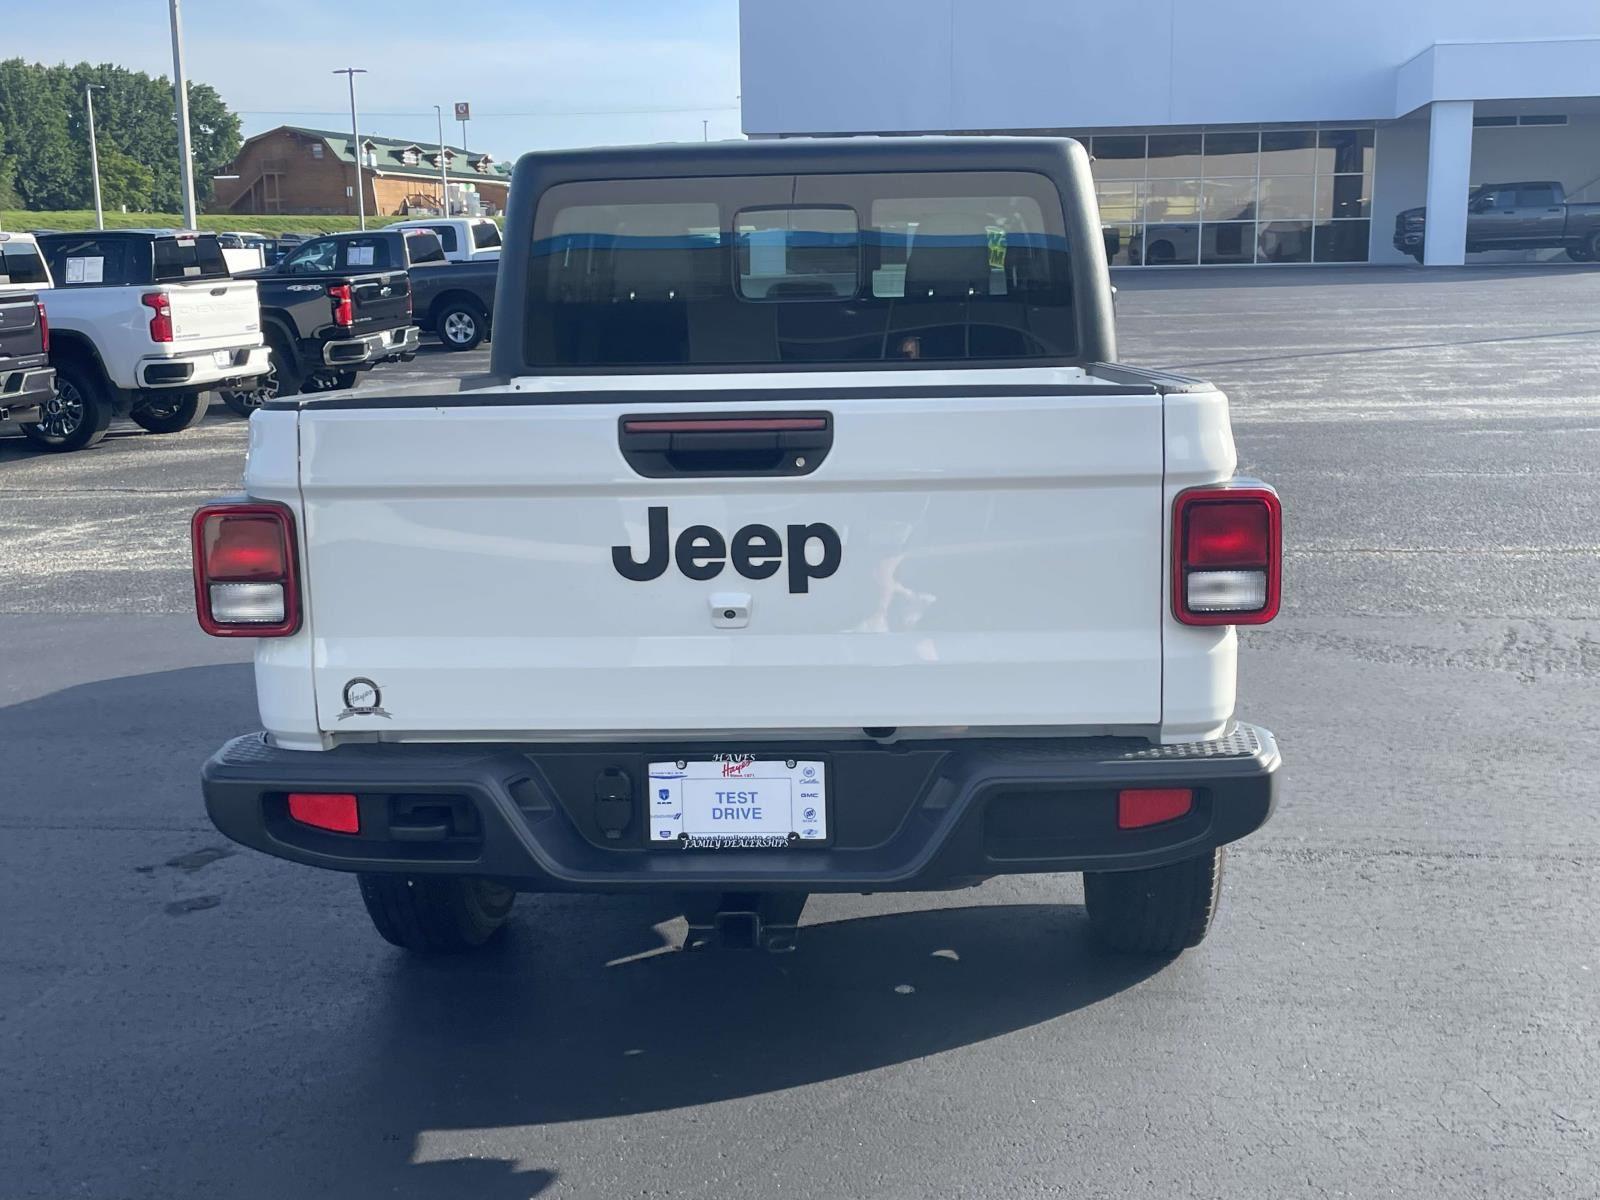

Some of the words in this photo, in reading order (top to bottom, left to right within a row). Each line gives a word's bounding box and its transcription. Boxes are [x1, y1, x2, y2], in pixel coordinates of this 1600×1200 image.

[611, 506, 842, 594] Jeep
[715, 791, 758, 804] TEST
[712, 807, 763, 820] DRIVE
[682, 839, 721, 850] FAMILY
